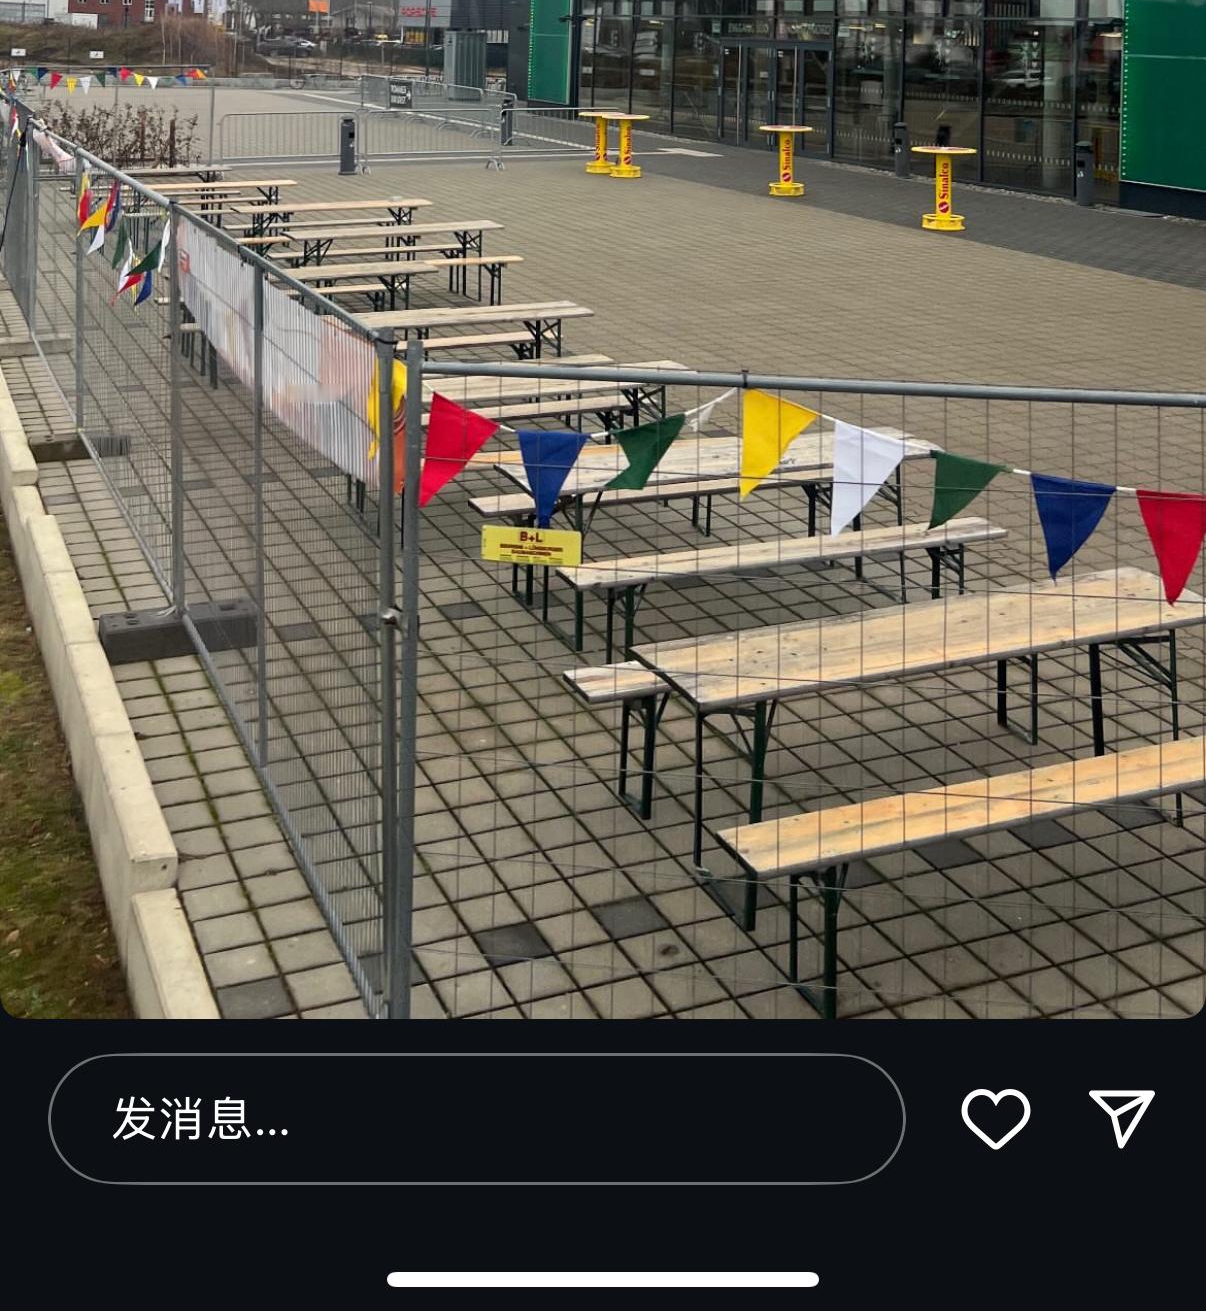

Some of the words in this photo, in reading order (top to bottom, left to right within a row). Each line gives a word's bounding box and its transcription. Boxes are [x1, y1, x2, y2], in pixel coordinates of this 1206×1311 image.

[782, 138, 792, 171] Sinalco
[939, 162, 950, 200] Sinalco
[519, 530, 544, 543] B+L
